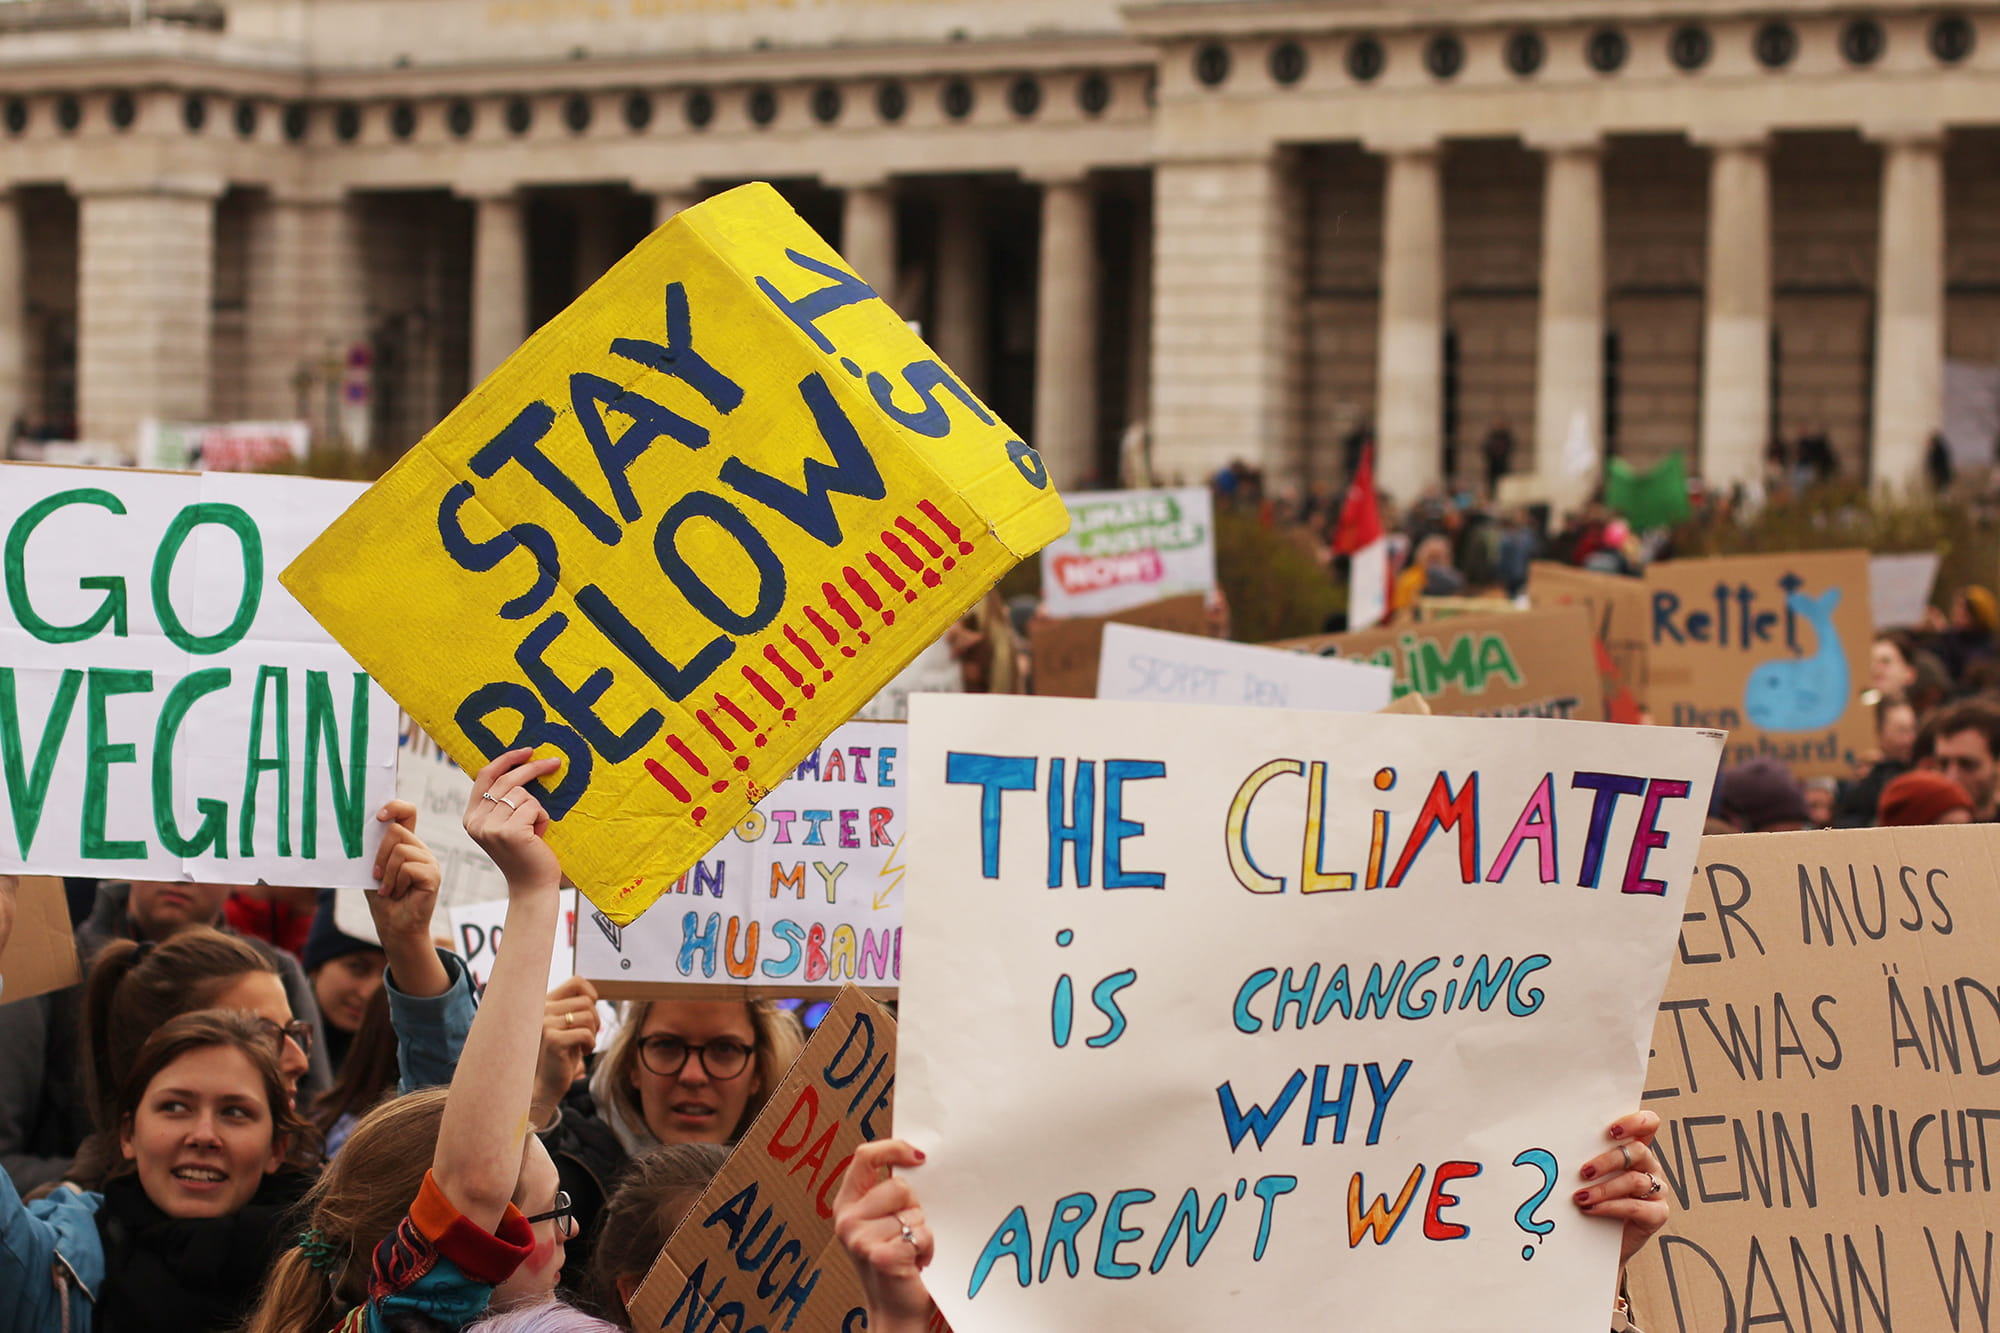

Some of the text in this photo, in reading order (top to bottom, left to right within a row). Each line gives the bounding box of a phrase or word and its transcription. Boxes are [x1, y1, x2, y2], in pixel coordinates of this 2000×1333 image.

[437, 282, 744, 620] STAY
[4, 487, 264, 655] GO
[455, 371, 887, 821] BELOW
[0, 665, 369, 861] VEGAN
[733, 808, 895, 849] OTTER
[946, 751, 1166, 890] THE
[769, 862, 848, 904] MY
[1798, 863, 1954, 946] MUSS
[1216, 1059, 1413, 1152] WHY
[1852, 1104, 2000, 1197] NICHT
[702, 1181, 822, 1331] AUCH
[968, 1174, 1298, 1300] AREN'T
[1347, 1162, 1483, 1249] WE
[1658, 1224, 1893, 1333] DANN
